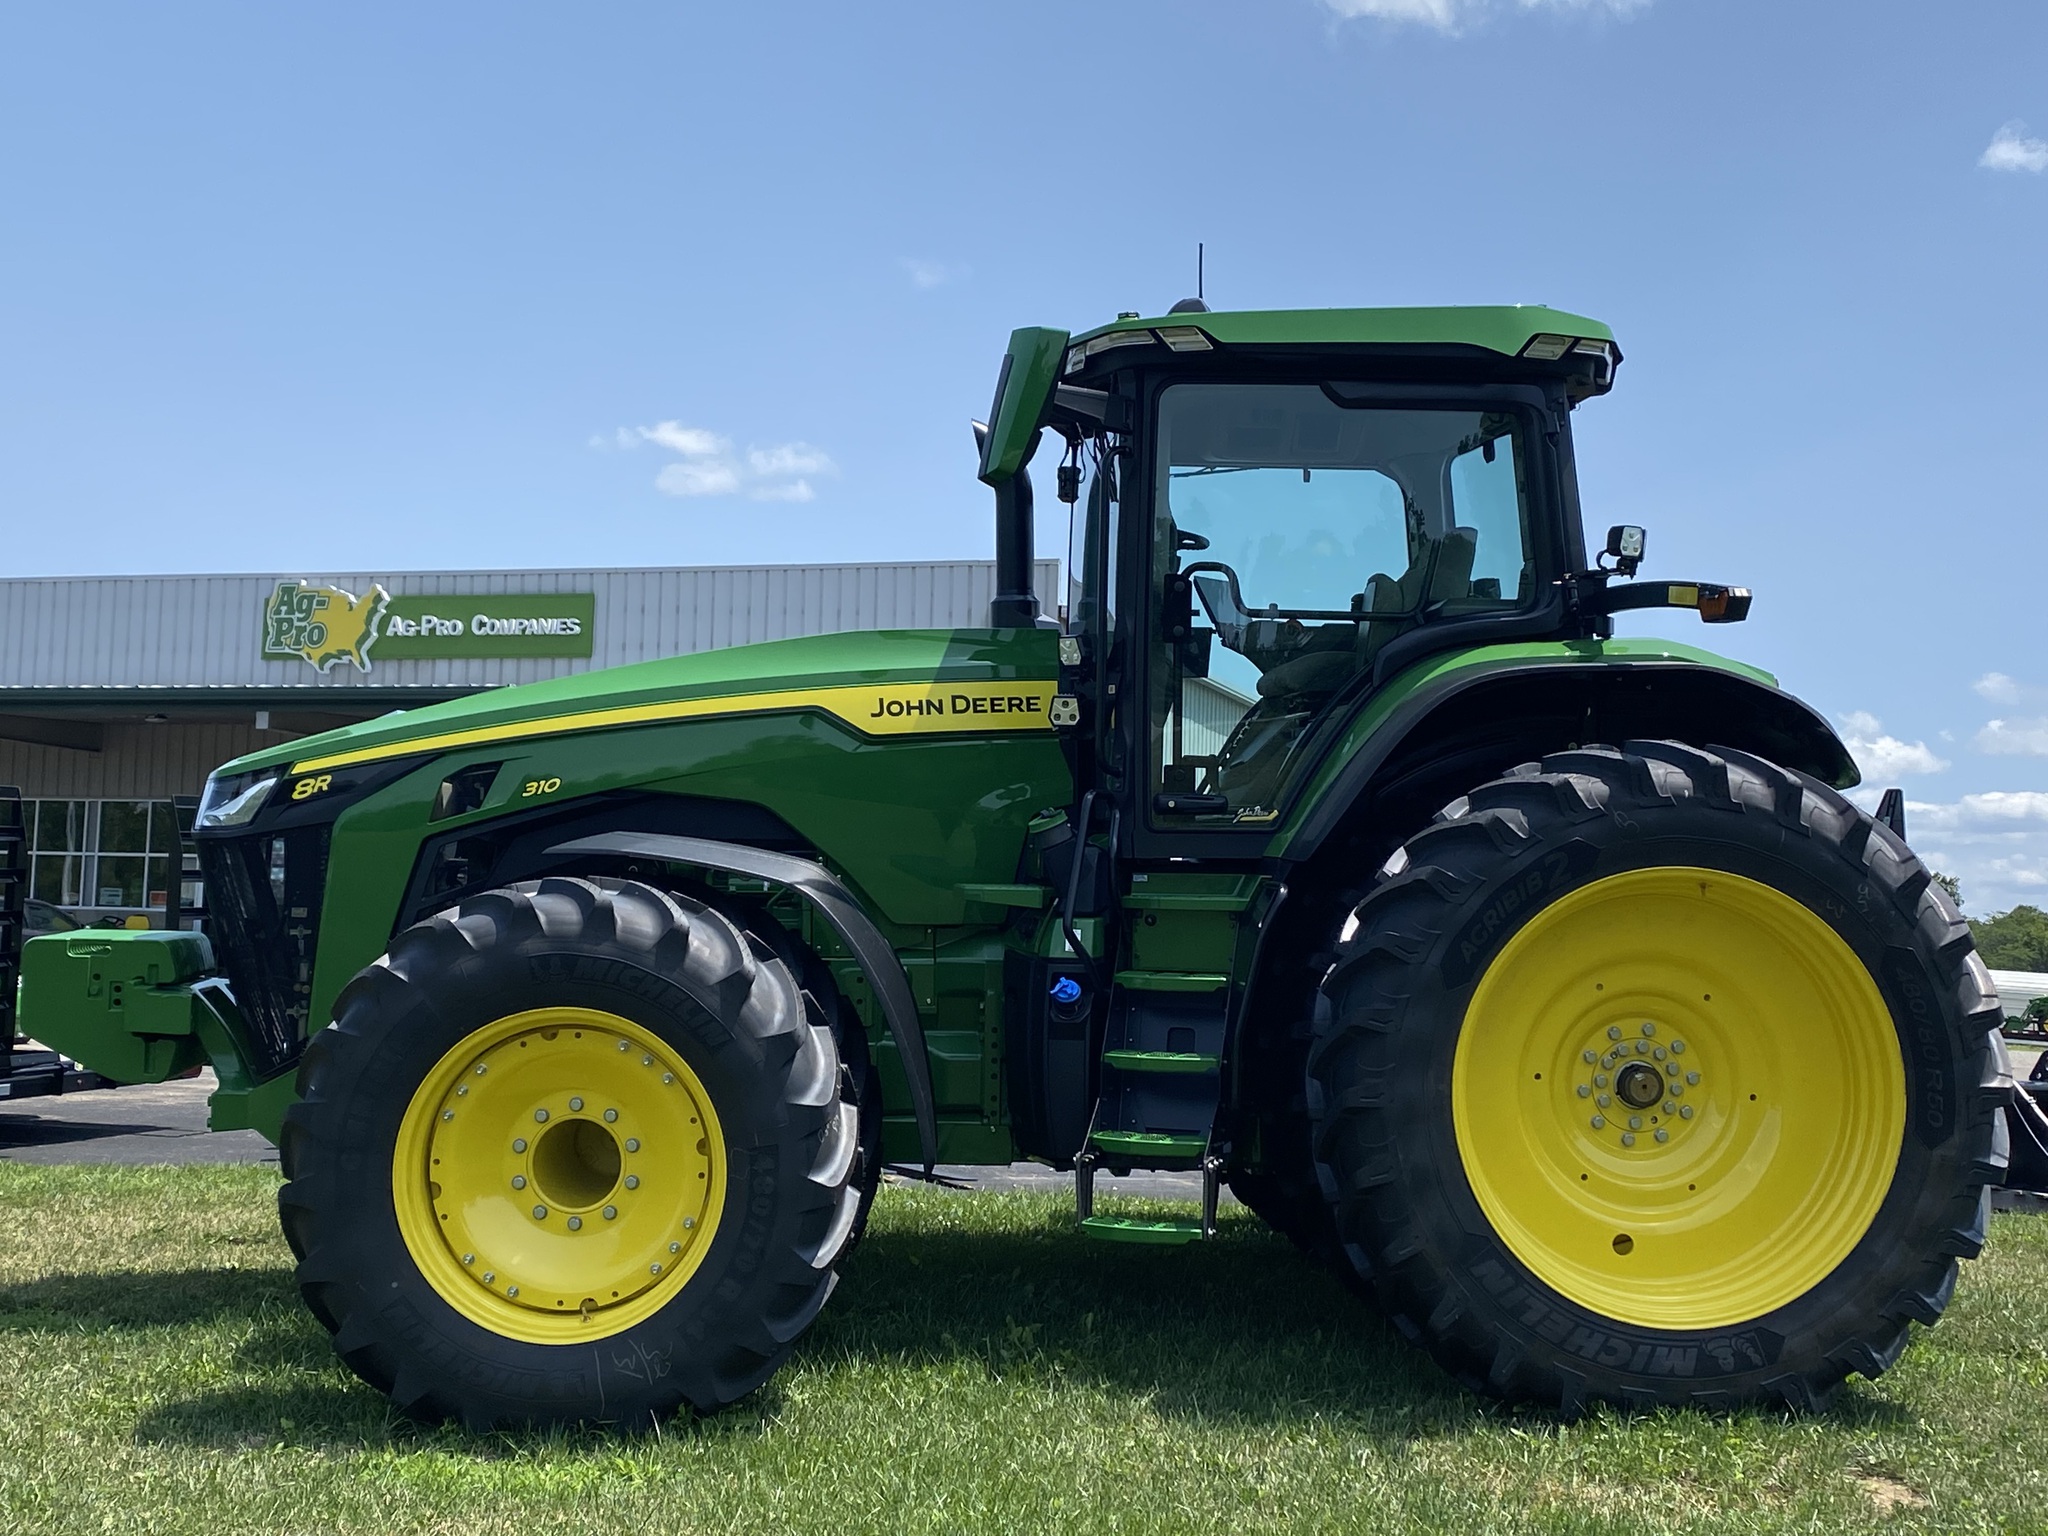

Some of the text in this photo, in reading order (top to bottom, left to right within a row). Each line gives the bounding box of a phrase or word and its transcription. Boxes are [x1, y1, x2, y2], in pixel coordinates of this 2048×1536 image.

[273, 583, 330, 621] Ag-
[271, 616, 327, 649] Pro
[870, 694, 1041, 718] JOHN DEERE
[291, 774, 332, 800] 8R
[522, 777, 561, 797] 310
[1460, 850, 1570, 964] AGRIBIB 2
[572, 958, 735, 1049] MICHELIN
[1470, 1258, 1699, 1377] MICHELIN
